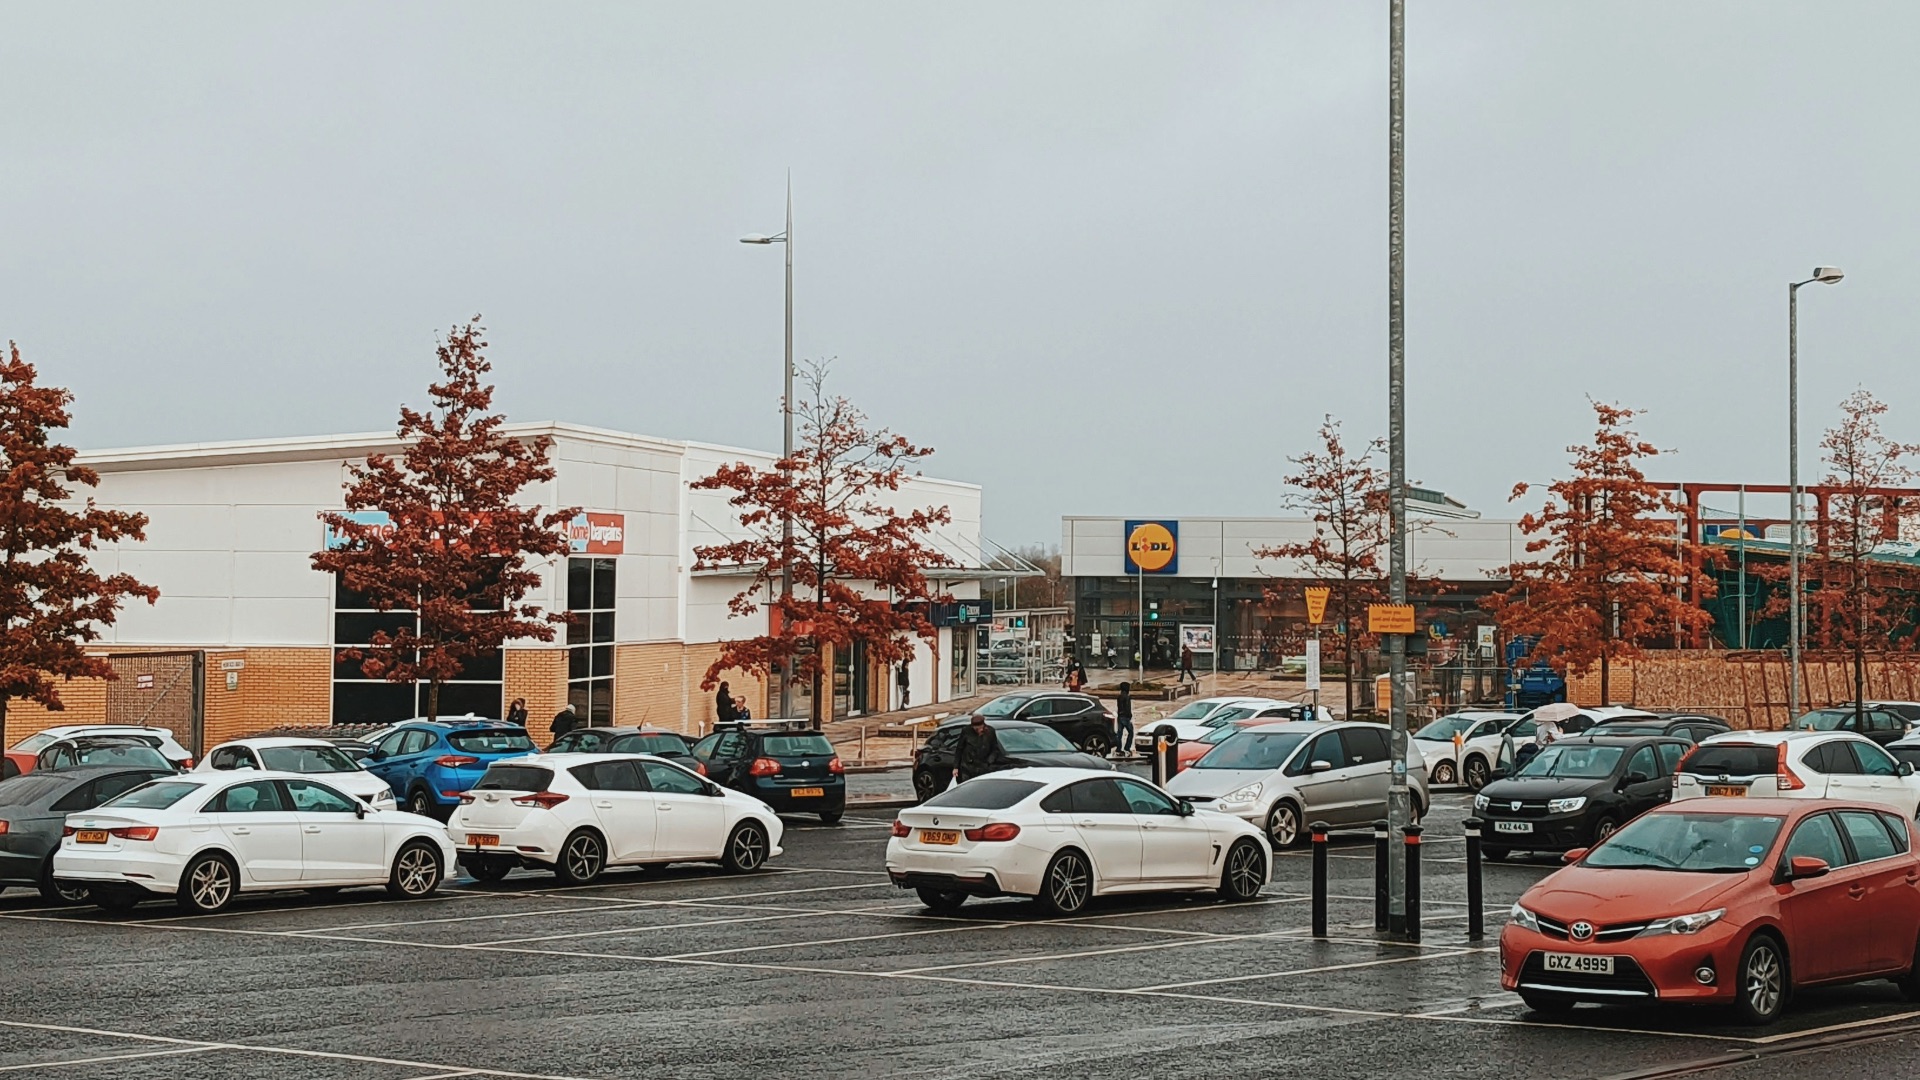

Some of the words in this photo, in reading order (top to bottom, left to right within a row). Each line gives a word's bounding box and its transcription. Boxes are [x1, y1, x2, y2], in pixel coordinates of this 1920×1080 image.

[590, 520, 623, 546] bargains
[1548, 955, 1572, 969] GXZ
[1574, 956, 1608, 971] 4999
